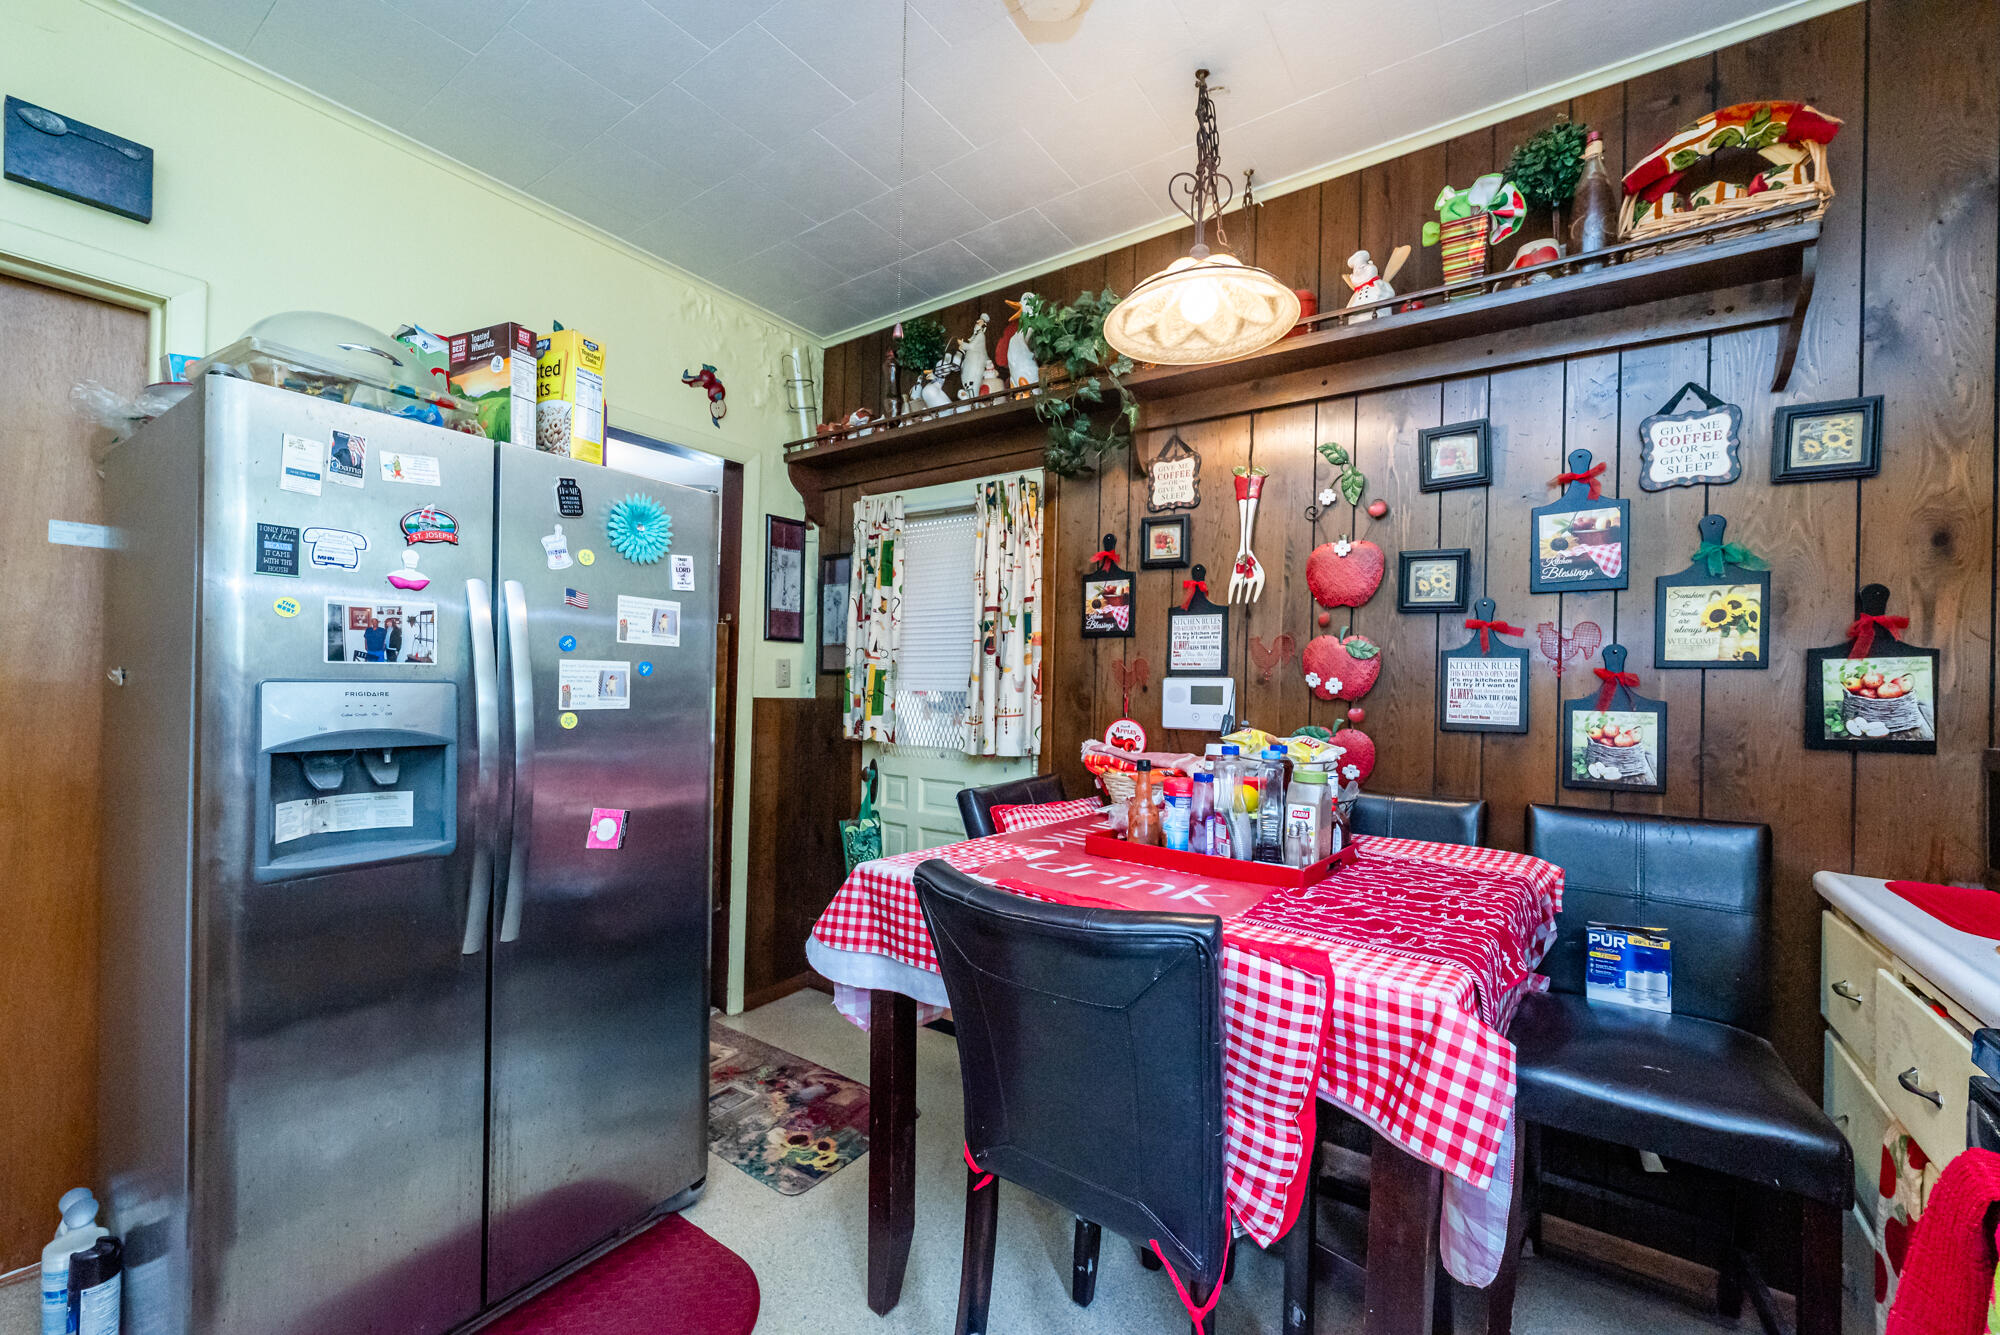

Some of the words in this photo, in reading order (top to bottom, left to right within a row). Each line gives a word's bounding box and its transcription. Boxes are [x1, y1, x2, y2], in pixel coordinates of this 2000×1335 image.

[471, 330, 490, 343] Toasted
[452, 345, 466, 353] BEST
[1660, 424, 1692, 436] GIVE
[1700, 421, 1720, 430] ME
[1659, 430, 1722, 447] COFFEE
[1681, 445, 1698, 454] OR
[1660, 455, 1692, 465] GIVE
[1700, 451, 1720, 460] ME
[331, 460, 362, 475] Obama
[1666, 462, 1713, 475] SLEEP
[1158, 470, 1191, 480] COFFEE
[1162, 492, 1185, 500] SLEEP
[263, 525, 279, 533] ONLY
[425, 531, 453, 540] JOSEPH
[264, 557, 279, 565] WITH
[1541, 556, 1573, 567] Kitchen
[1541, 566, 1594, 580] Blessings
[1669, 590, 1705, 600] Sunshine
[1086, 620, 1114, 631] Blessings
[1173, 617, 1200, 625] KITCHEN
[1674, 626, 1702, 636] always
[1449, 661, 1488, 669] KITCHEN
[1491, 661, 1519, 669] RULES
[1450, 688, 1473, 699] ALWAYS
[1026, 862, 1230, 908] drink
